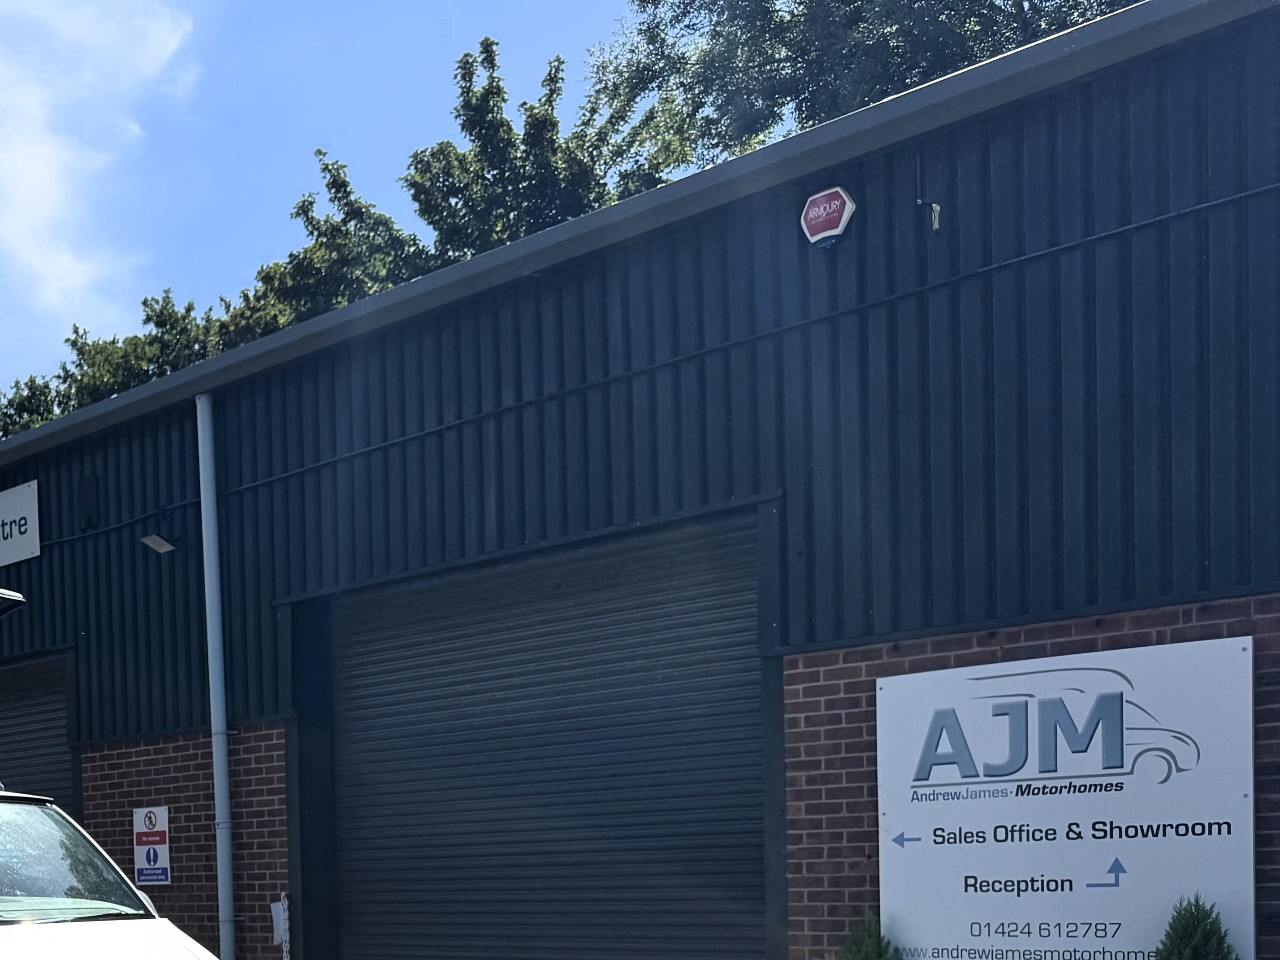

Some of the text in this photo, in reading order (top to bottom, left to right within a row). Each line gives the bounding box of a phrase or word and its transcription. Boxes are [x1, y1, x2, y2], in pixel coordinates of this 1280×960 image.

[912, 691, 1124, 781] AJM
[932, 818, 1233, 845] Sales Office & Showroom
[963, 874, 1074, 897] Reception
[970, 921, 1122, 939] 01424 612787
